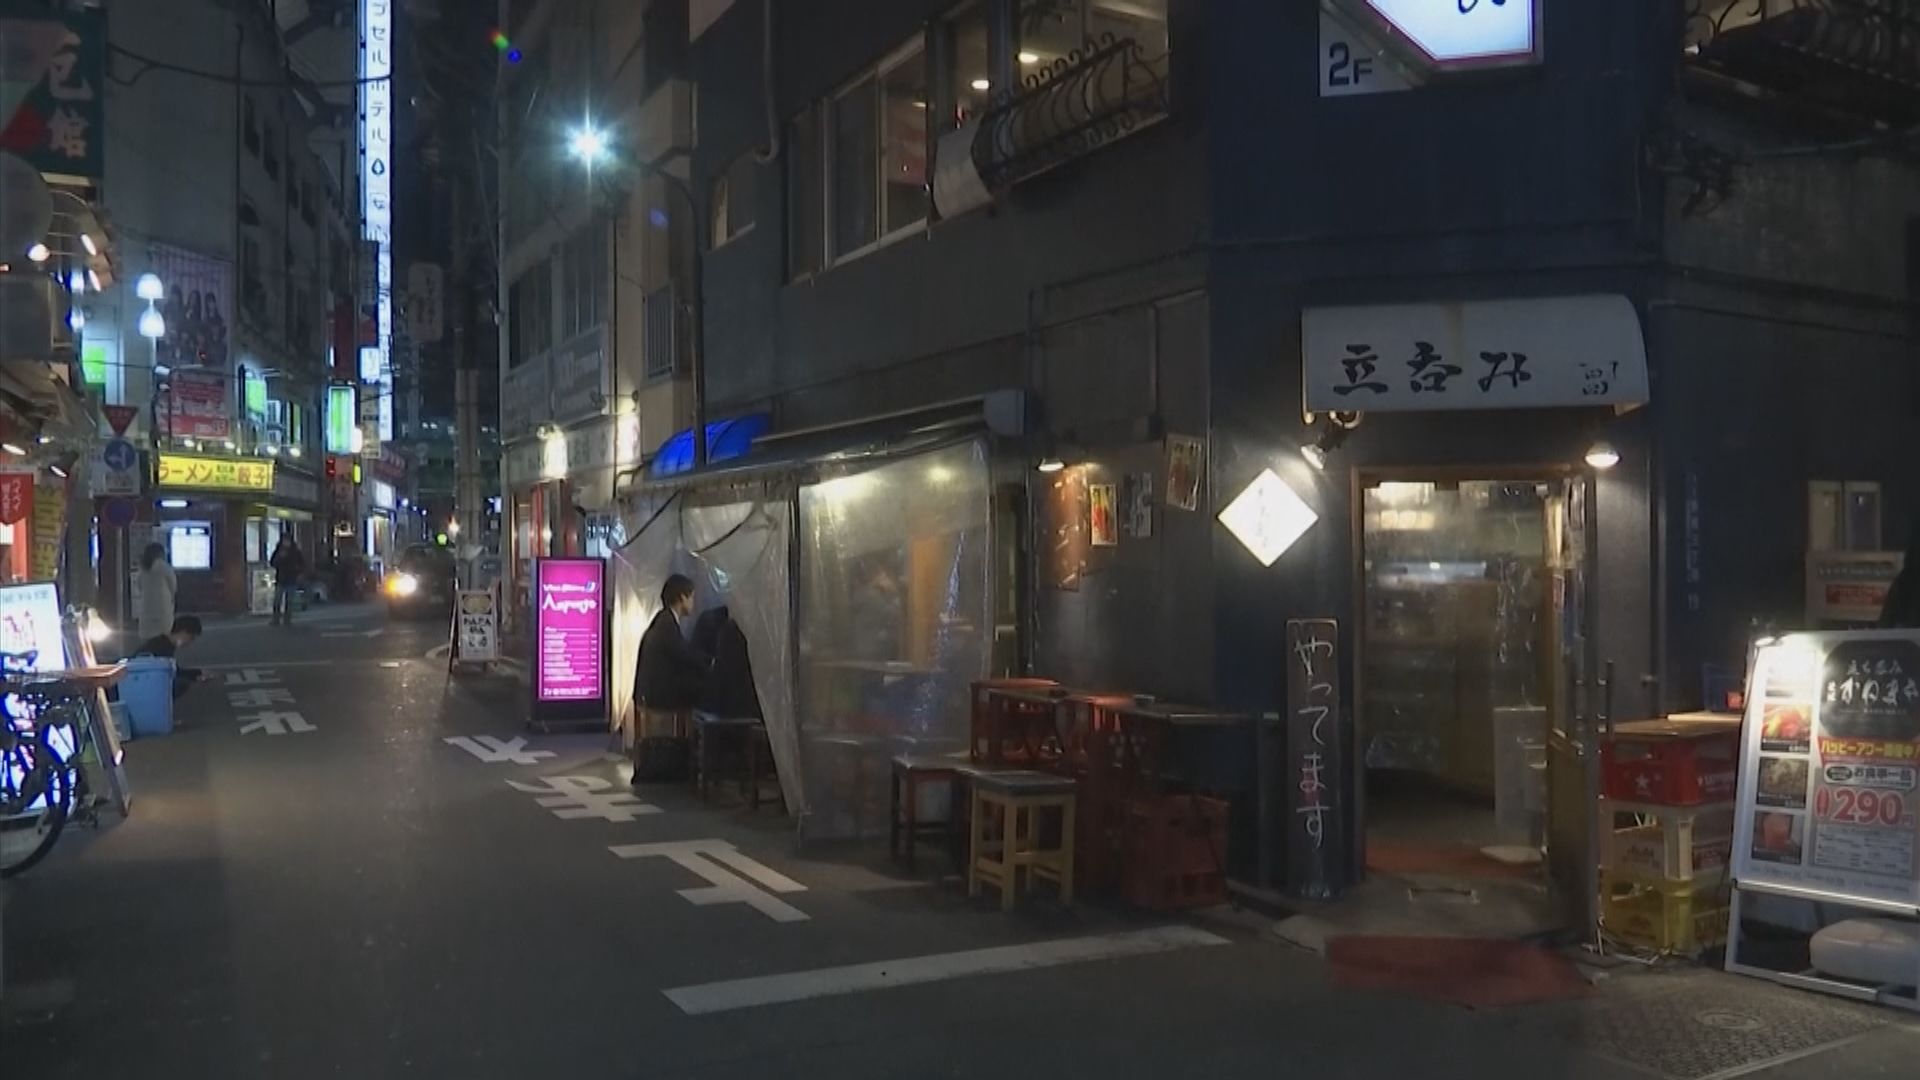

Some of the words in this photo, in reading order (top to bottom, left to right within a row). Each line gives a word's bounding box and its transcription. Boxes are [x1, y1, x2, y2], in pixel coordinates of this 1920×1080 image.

[1329, 42, 1373, 86] 2F
[1333, 341, 1531, 396] 立呑み
[159, 460, 213, 483] ラーメン
[225, 669, 318, 735] 止まれ
[1294, 635, 1333, 848] やってます
